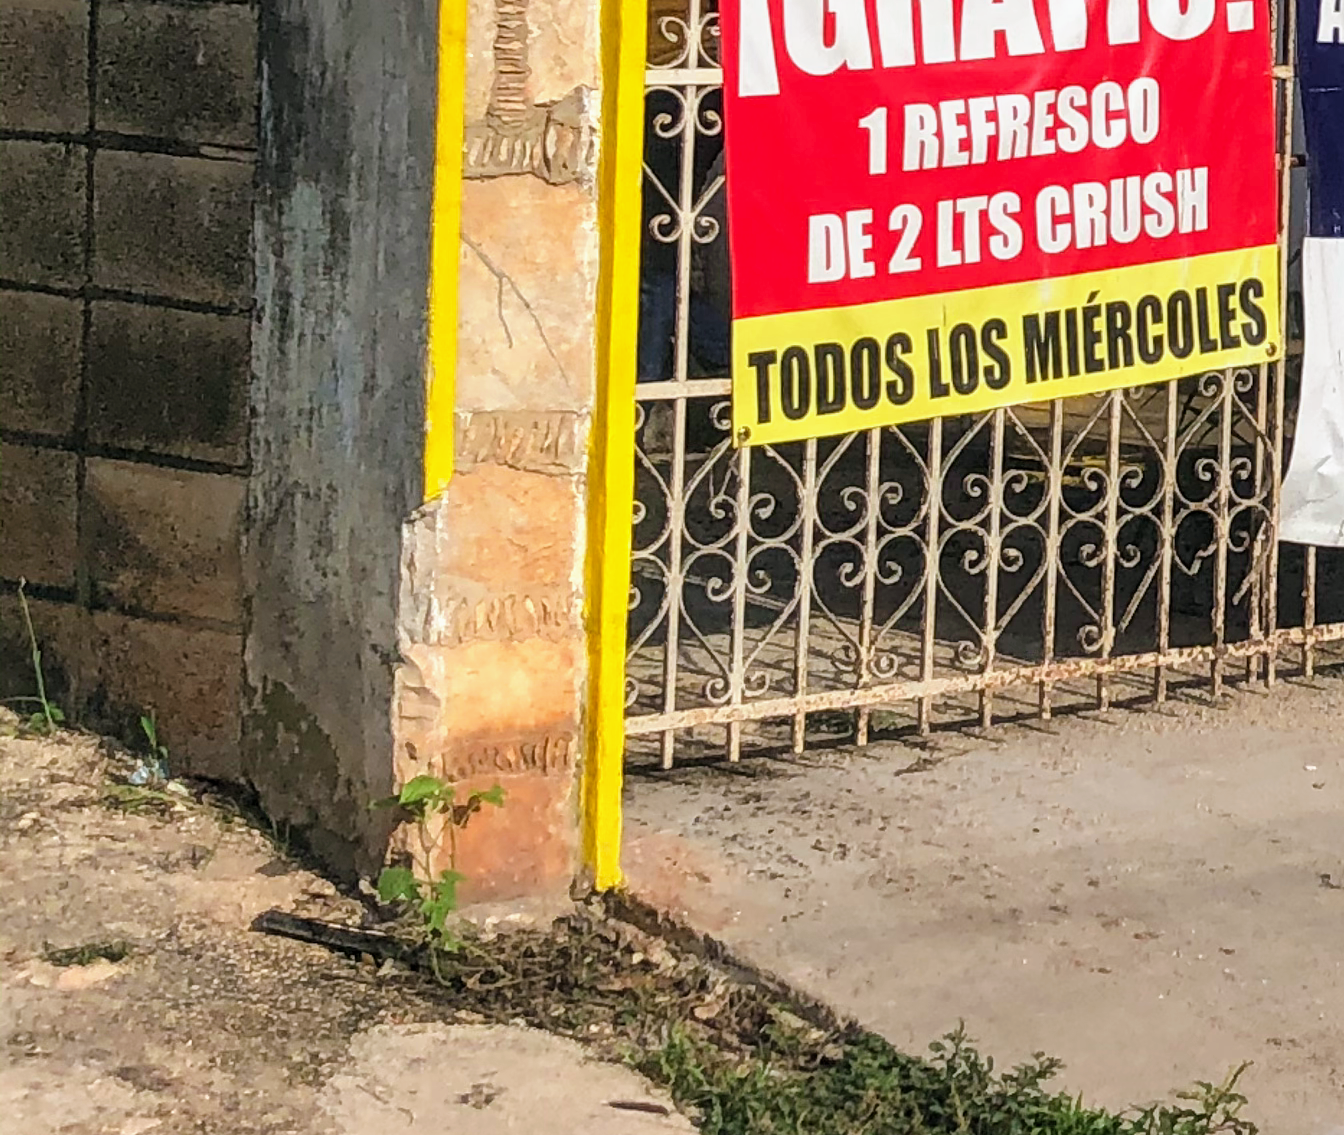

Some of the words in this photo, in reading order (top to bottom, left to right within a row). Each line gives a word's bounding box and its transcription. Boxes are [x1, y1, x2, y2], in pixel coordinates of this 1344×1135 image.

[858, 106, 887, 175] 1
[902, 76, 1161, 172] REFRESCO
[807, 209, 876, 284] DE
[888, 204, 922, 273] 2
[936, 193, 1023, 266] LTS
[1034, 166, 1210, 254] CRUSH
[747, 331, 915, 425] TODOS
[925, 317, 1009, 400] LOS
[1021, 288, 1268, 384] MIÉRCOLES
